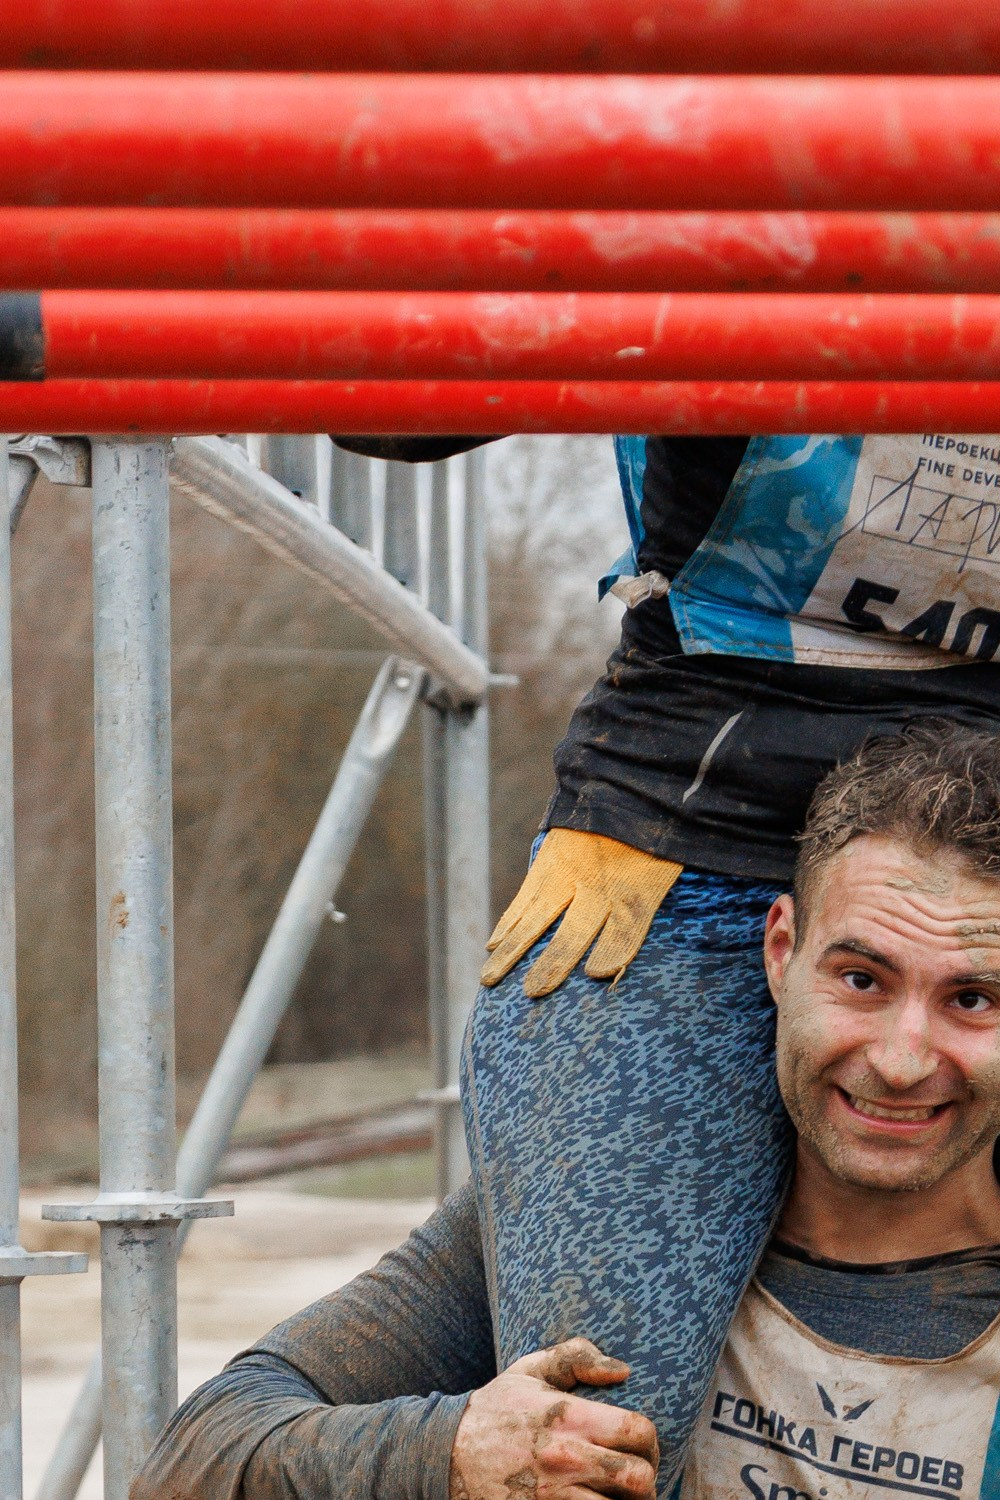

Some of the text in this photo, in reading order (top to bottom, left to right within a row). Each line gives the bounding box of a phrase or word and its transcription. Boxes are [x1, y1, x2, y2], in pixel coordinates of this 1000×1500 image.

[917, 457, 956, 478] FINE
[712, 1391, 965, 1491] ГОНКА ГЕРОЕВ
